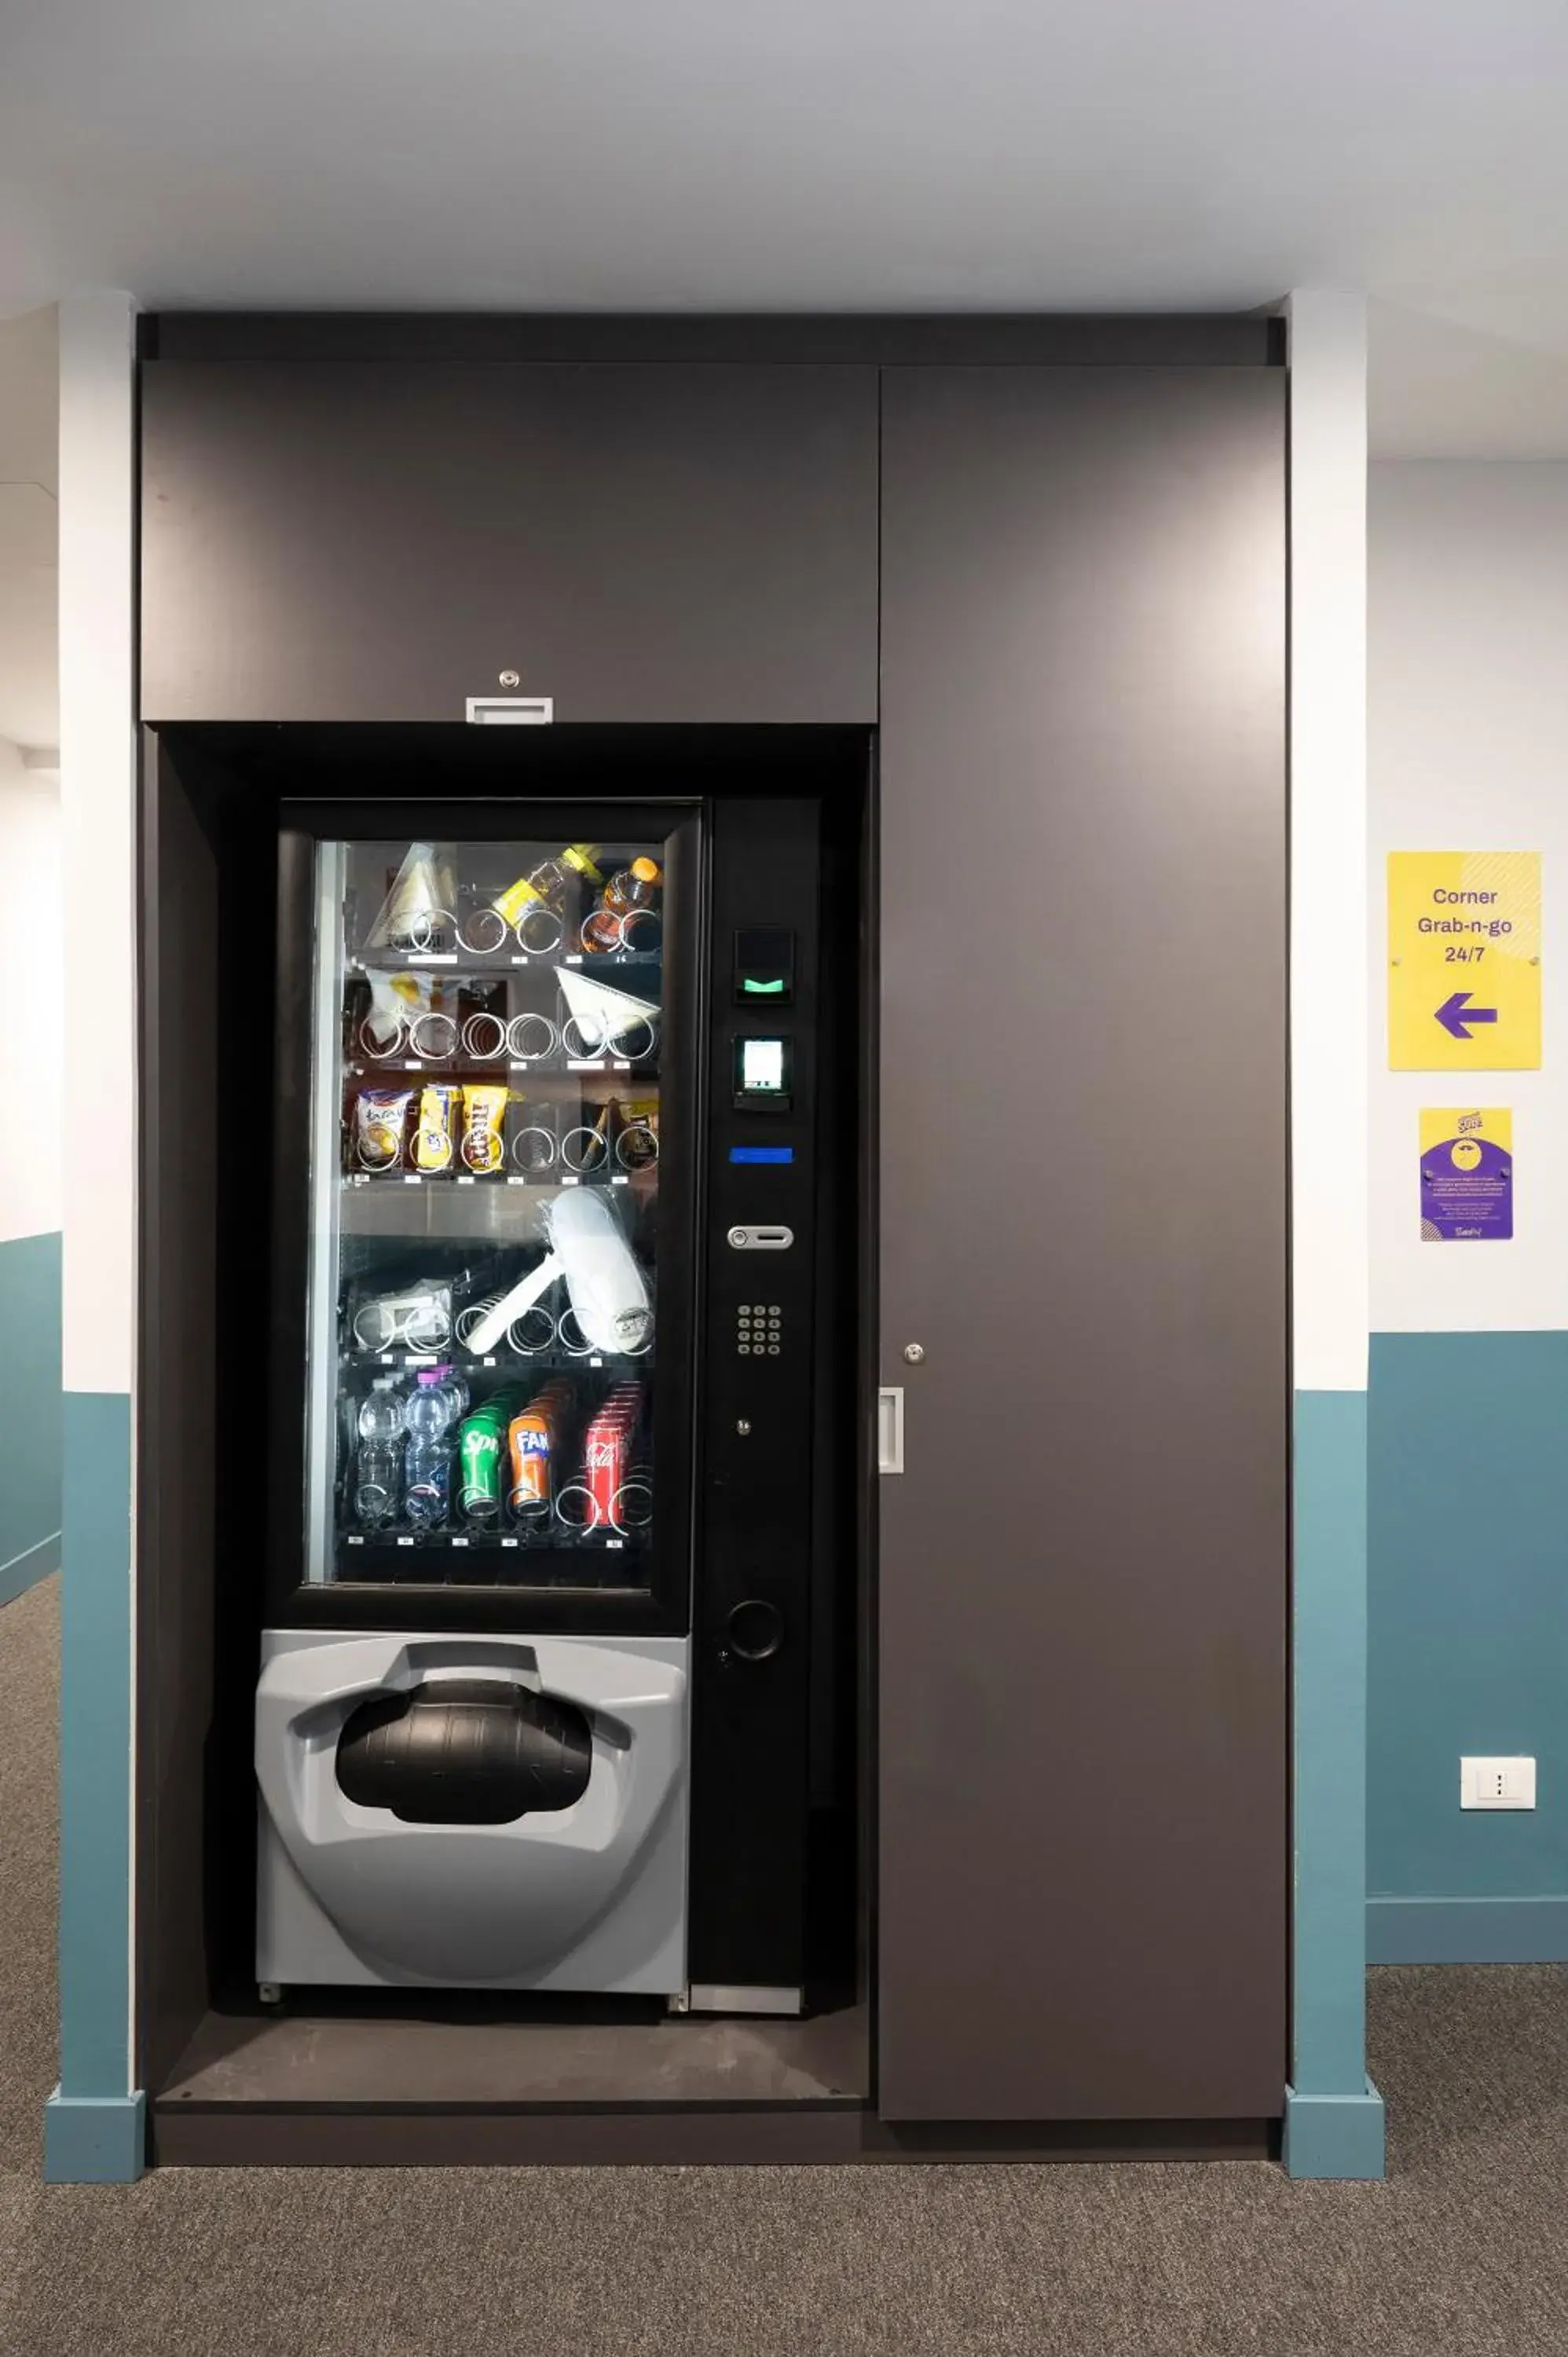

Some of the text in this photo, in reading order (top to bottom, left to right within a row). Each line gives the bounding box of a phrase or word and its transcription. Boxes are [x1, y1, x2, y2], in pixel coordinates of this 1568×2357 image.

[1433, 889, 1498, 904] Corner
[1418, 917, 1512, 937] Grab-n-go
[1445, 945, 1486, 962] 24/7
